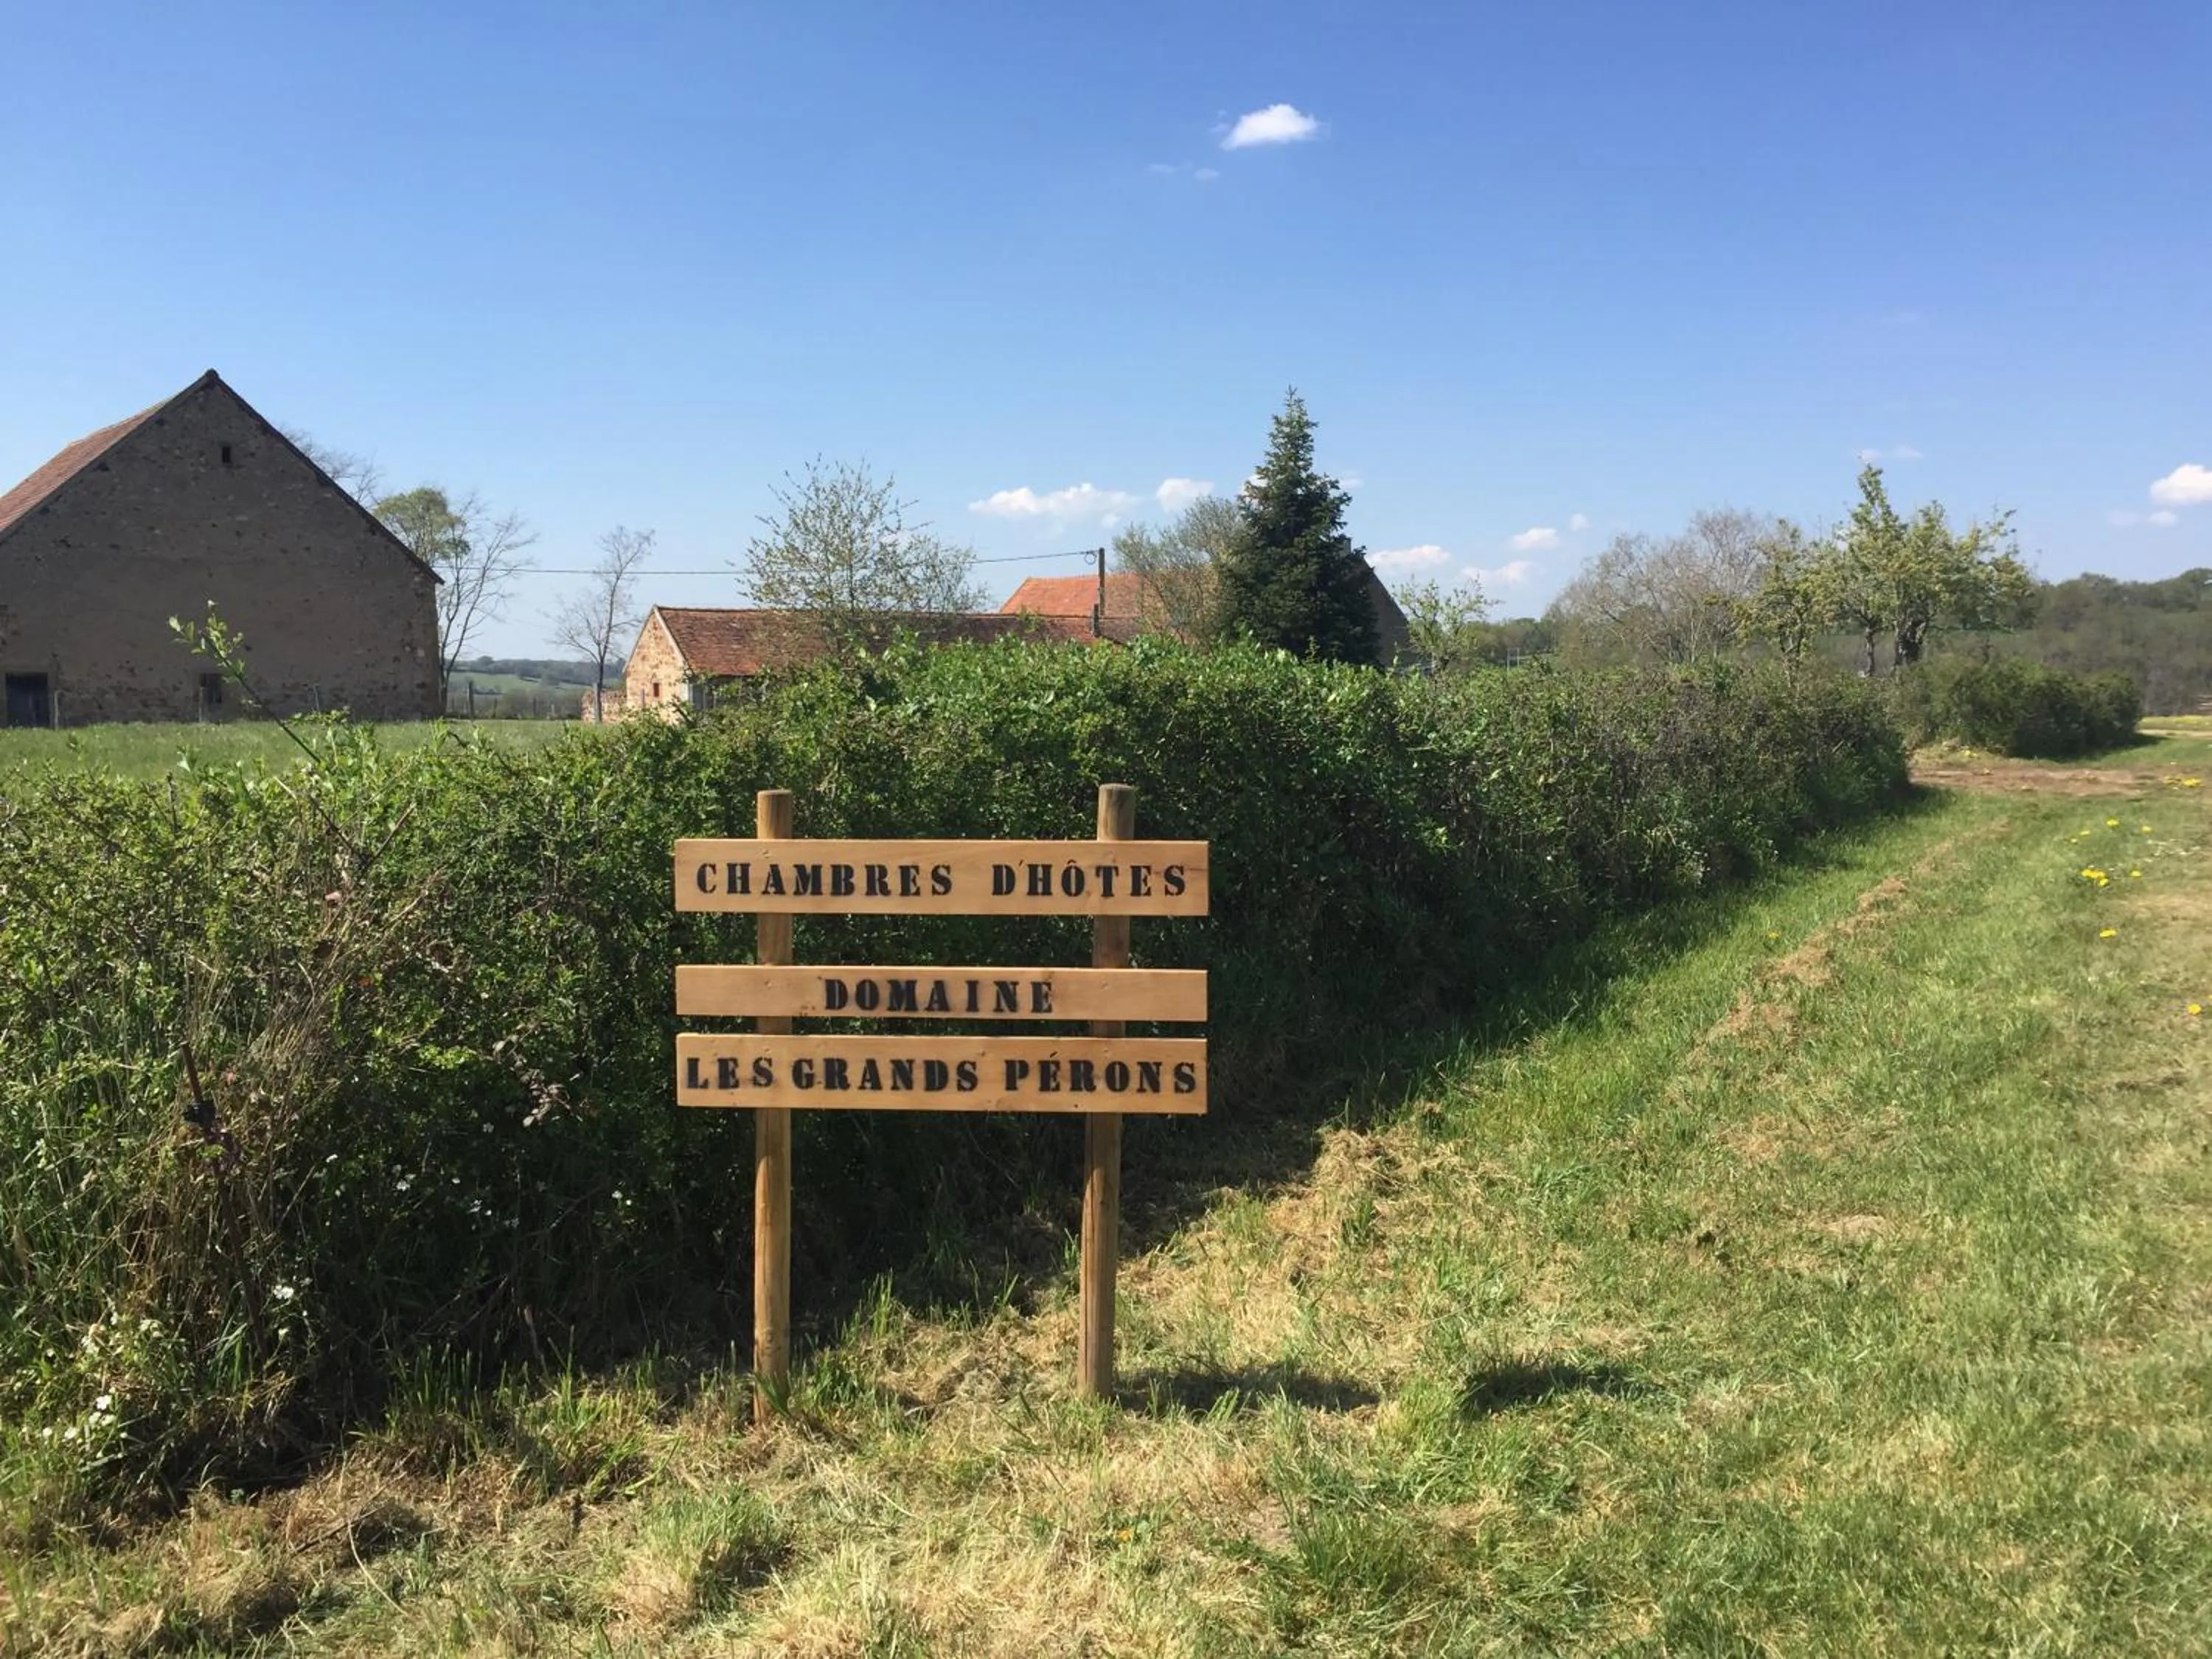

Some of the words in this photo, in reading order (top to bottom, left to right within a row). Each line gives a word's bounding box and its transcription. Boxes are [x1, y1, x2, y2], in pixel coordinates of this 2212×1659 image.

[696, 862, 953, 897] CHAMBRES
[991, 859, 1186, 898] D'HÔTES
[824, 978, 1054, 1014] DOMAINE
[686, 1057, 774, 1090] LES
[791, 1057, 979, 1093] GRANDS
[1004, 1051, 1197, 1095] PÉRONS
